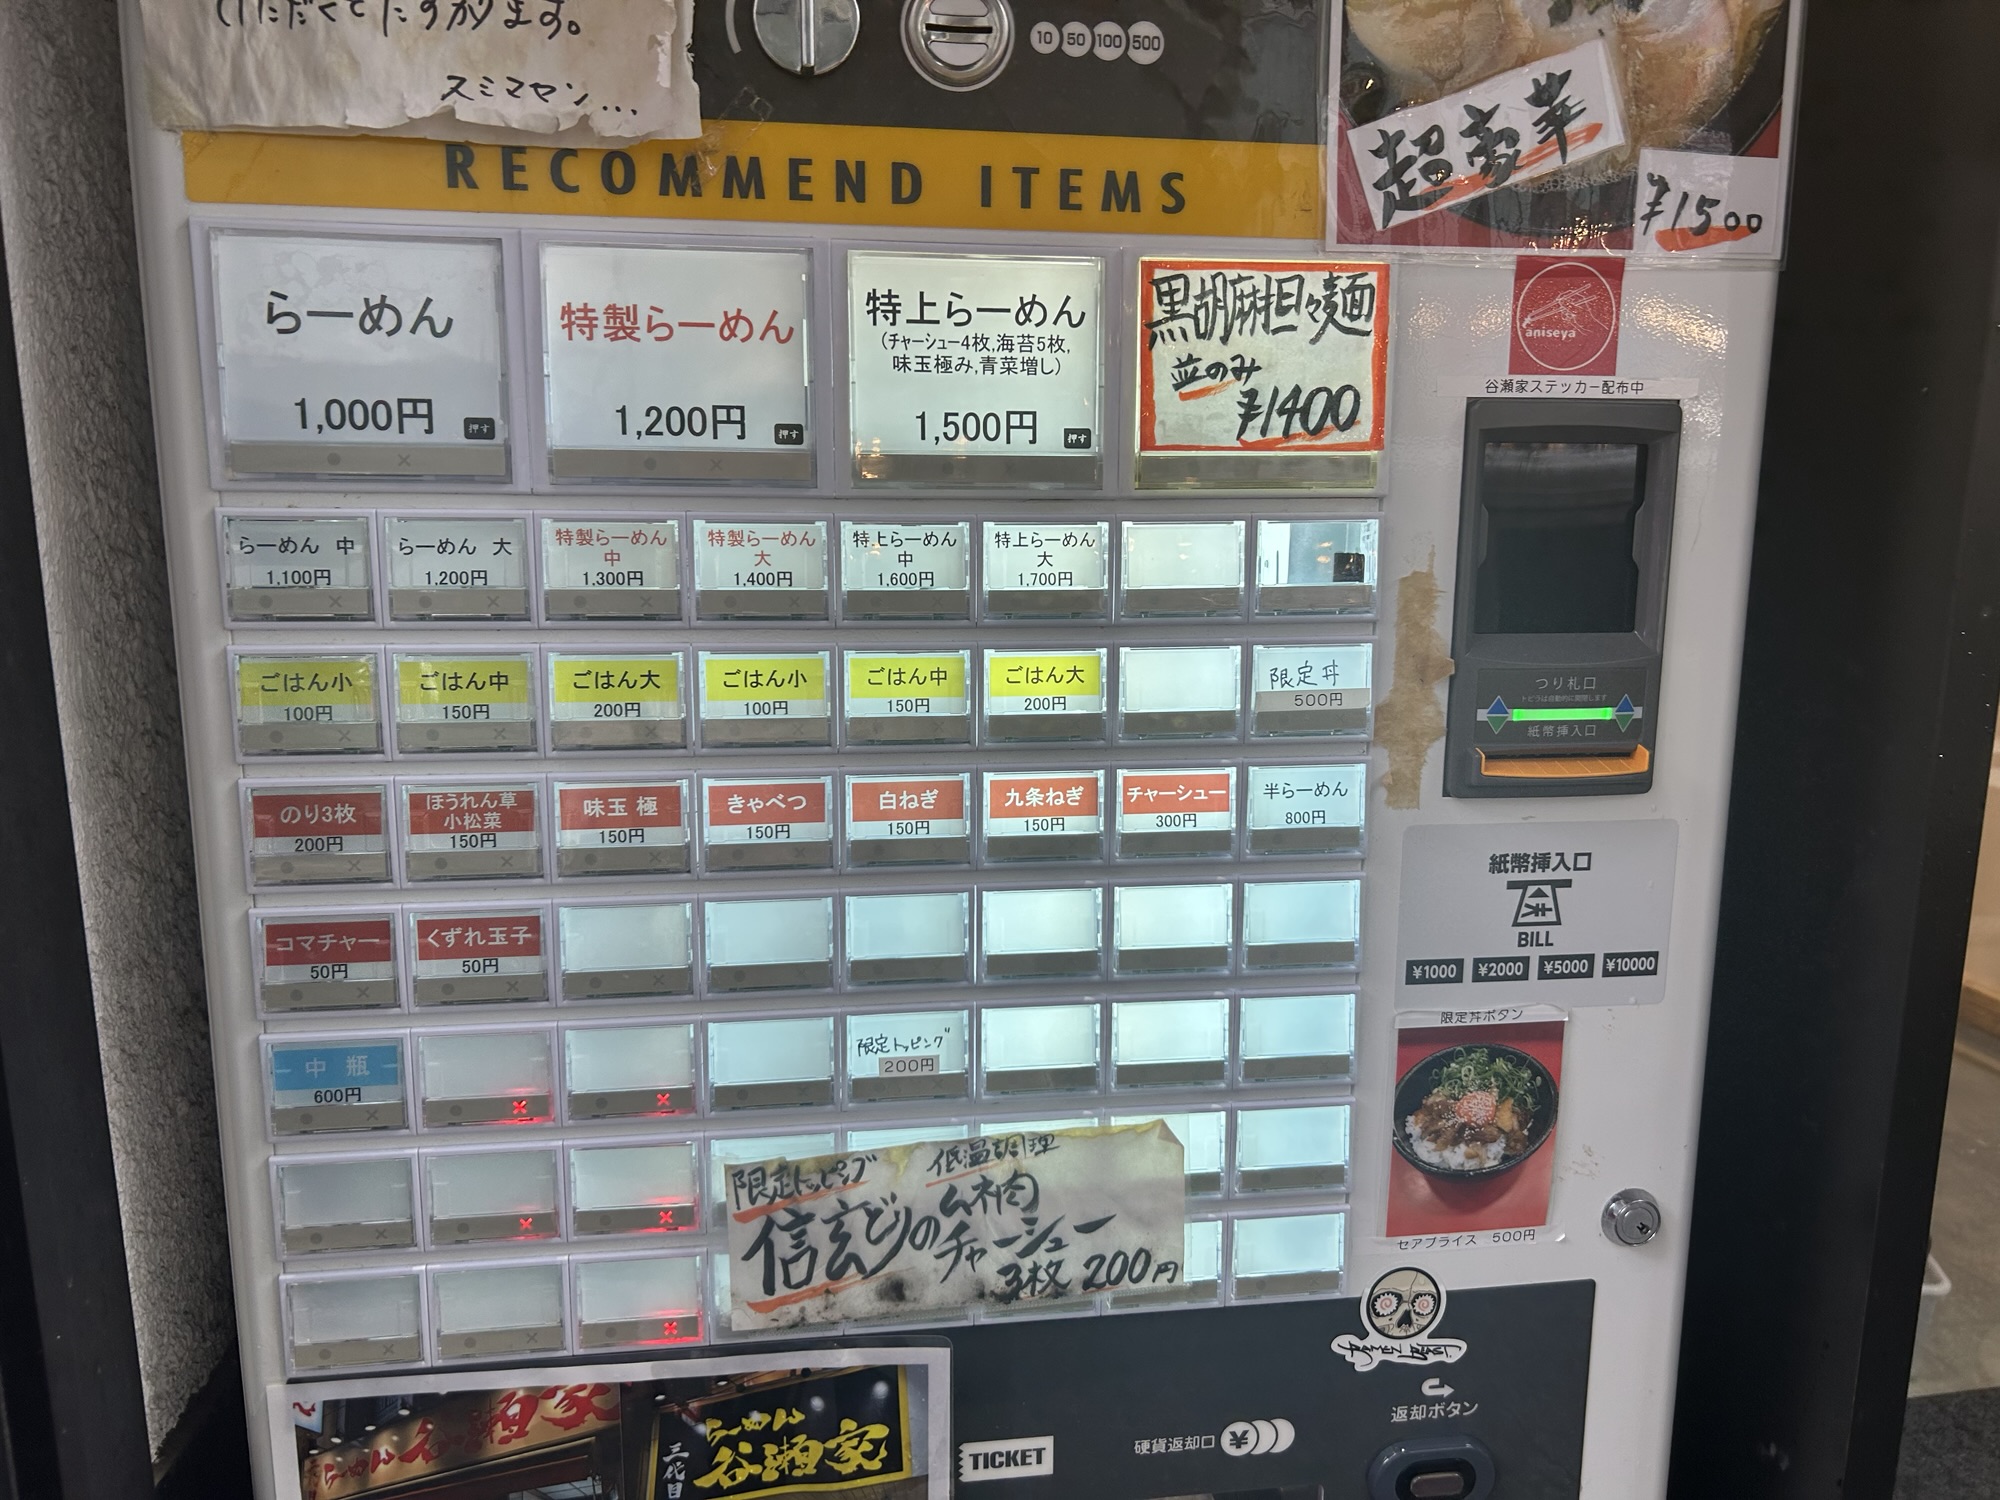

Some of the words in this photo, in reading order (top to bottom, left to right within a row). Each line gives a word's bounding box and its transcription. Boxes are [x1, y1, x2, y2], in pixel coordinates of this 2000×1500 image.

[1036, 30, 1054, 46] 10
[1066, 32, 1086, 48] 50
[1097, 33, 1122, 50] 100
[1131, 35, 1161, 52] 500
[445, 143, 924, 205] RECOMMEND
[980, 164, 1187, 214] ITEMS
[265, 289, 454, 338] らーめん
[865, 288, 1087, 329] 特上らーめん
[560, 301, 796, 344] 特製らーめん
[1170, 353, 1263, 392] 並のみ
[1485, 378, 1645, 396] 谷瀬家ステッカー配布中
[294, 398, 435, 434] 1,000円
[615, 404, 747, 440] 1,200円
[777, 428, 801, 440] 押す
[915, 410, 1038, 445] 1,500円
[1066, 433, 1088, 445] 押す
[239, 536, 320, 556] らーめん
[335, 536, 355, 556] 中
[555, 527, 668, 547] 特製らーめん
[707, 529, 816, 548] 特製らーめん
[853, 531, 957, 549] 特上らーめん
[994, 531, 1096, 549] 特上らーめん
[399, 537, 477, 557] らーめん
[492, 537, 513, 557] 大
[603, 549, 621, 567] 中
[754, 550, 772, 567] 大
[897, 551, 914, 568] 中
[1036, 551, 1054, 567] 大
[266, 569, 332, 586] 1,100円
[424, 569, 489, 587] 1,200円
[582, 570, 645, 587] 1,300円
[733, 571, 794, 588] 1,400円
[877, 571, 935, 587] 1,600円
[1018, 571, 1074, 587] 1,700円
[260, 671, 353, 693] ごはん小
[420, 670, 510, 692] ごはん中
[573, 669, 661, 690] ごはん大
[723, 669, 808, 689] ごはん小
[867, 666, 948, 686] ごはん中
[1005, 665, 1085, 684] ごはん大
[1269, 659, 1340, 690] 限定丼
[1535, 676, 1597, 690] つり札口
[744, 700, 789, 716] 100円
[887, 698, 930, 713] 150円
[1024, 696, 1067, 711] 200円
[1294, 692, 1343, 707] 500円
[284, 705, 333, 722] 100円
[442, 703, 491, 720] 150円
[593, 702, 641, 718] 200円
[1527, 724, 1597, 738] 紙幣挿入口
[879, 788, 939, 811] 白ねぎ
[1004, 785, 1085, 808] 九条ねぎ
[1126, 783, 1227, 803] チャーシュー
[1263, 781, 1349, 800] 半らーめん
[426, 791, 518, 811] ほうれん草
[583, 796, 628, 818] 味玉
[636, 795, 658, 817] 極
[727, 793, 807, 814] きゃべつ
[280, 803, 357, 825] のり3枚
[443, 812, 502, 830] 小松菜
[1156, 813, 1197, 828] 300円
[1285, 810, 1326, 825] 800円
[746, 824, 791, 840] 150円
[887, 820, 930, 835] 150円
[1024, 817, 1065, 832] 150円
[294, 836, 344, 852] 200円
[451, 833, 497, 849] 150円
[599, 828, 645, 844] 150円
[1488, 852, 1592, 875] 紙幣挿入口
[276, 933, 380, 952] コマチャー
[426, 925, 532, 948] くずれ玉子
[1517, 931, 1554, 948] BILL
[310, 963, 348, 980] 50円
[462, 957, 499, 974] 50円
[1412, 964, 1457, 979] ¥1000
[1478, 961, 1524, 977] ¥2000
[1543, 959, 1589, 975] ¥5000
[1605, 956, 1655, 972] ¥10000
[1440, 1008, 1524, 1025] 限定丼ボタン
[305, 1057, 326, 1079] 中
[346, 1054, 370, 1077] 瓶
[884, 1057, 935, 1073] 200円
[314, 1087, 362, 1104] 600円
[926, 1133, 1061, 1177] 低温調理
[1492, 1229, 1536, 1243] 500円
[934, 1213, 1117, 1283] チャーシュー
[1082, 1247, 1178, 1291] 200円
[1390, 1401, 1479, 1423] 返却ボタン
[1133, 1435, 1215, 1456] 硬貨返却口
[968, 1447, 1046, 1471] TICKET
[662, 1441, 690, 1499] 三代目
